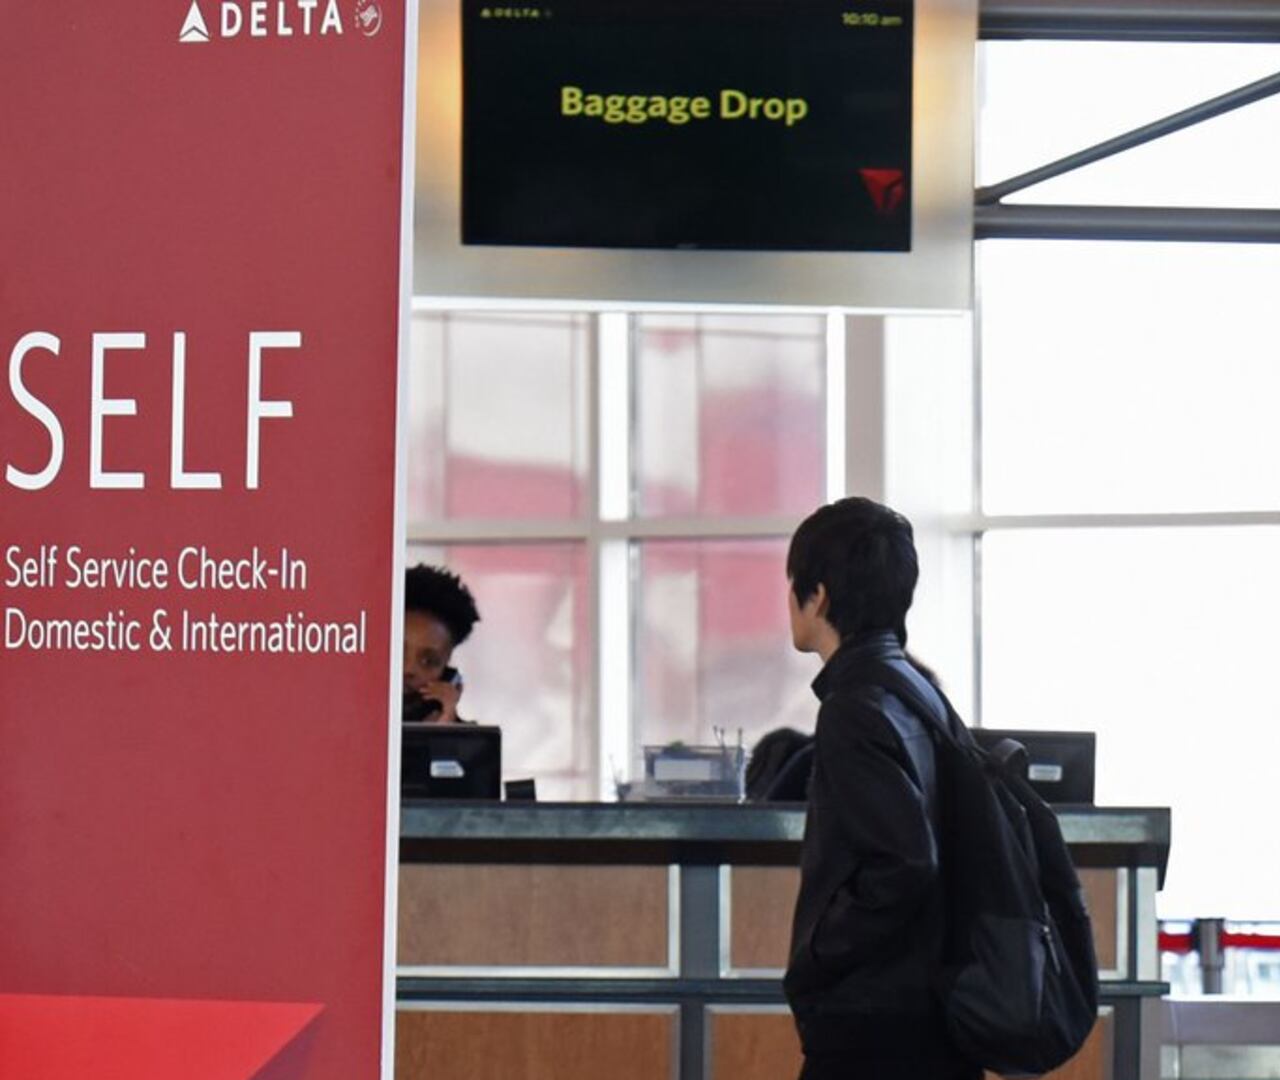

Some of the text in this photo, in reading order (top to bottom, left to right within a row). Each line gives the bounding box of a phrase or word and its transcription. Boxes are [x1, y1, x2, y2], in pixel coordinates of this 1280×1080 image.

[220, 0, 344, 37] DELTA
[561, 86, 808, 126] Baggage Drop
[5, 331, 301, 490] SELF
[5, 545, 307, 590] Self Service Check-In
[5, 607, 366, 653] Domestic & International
